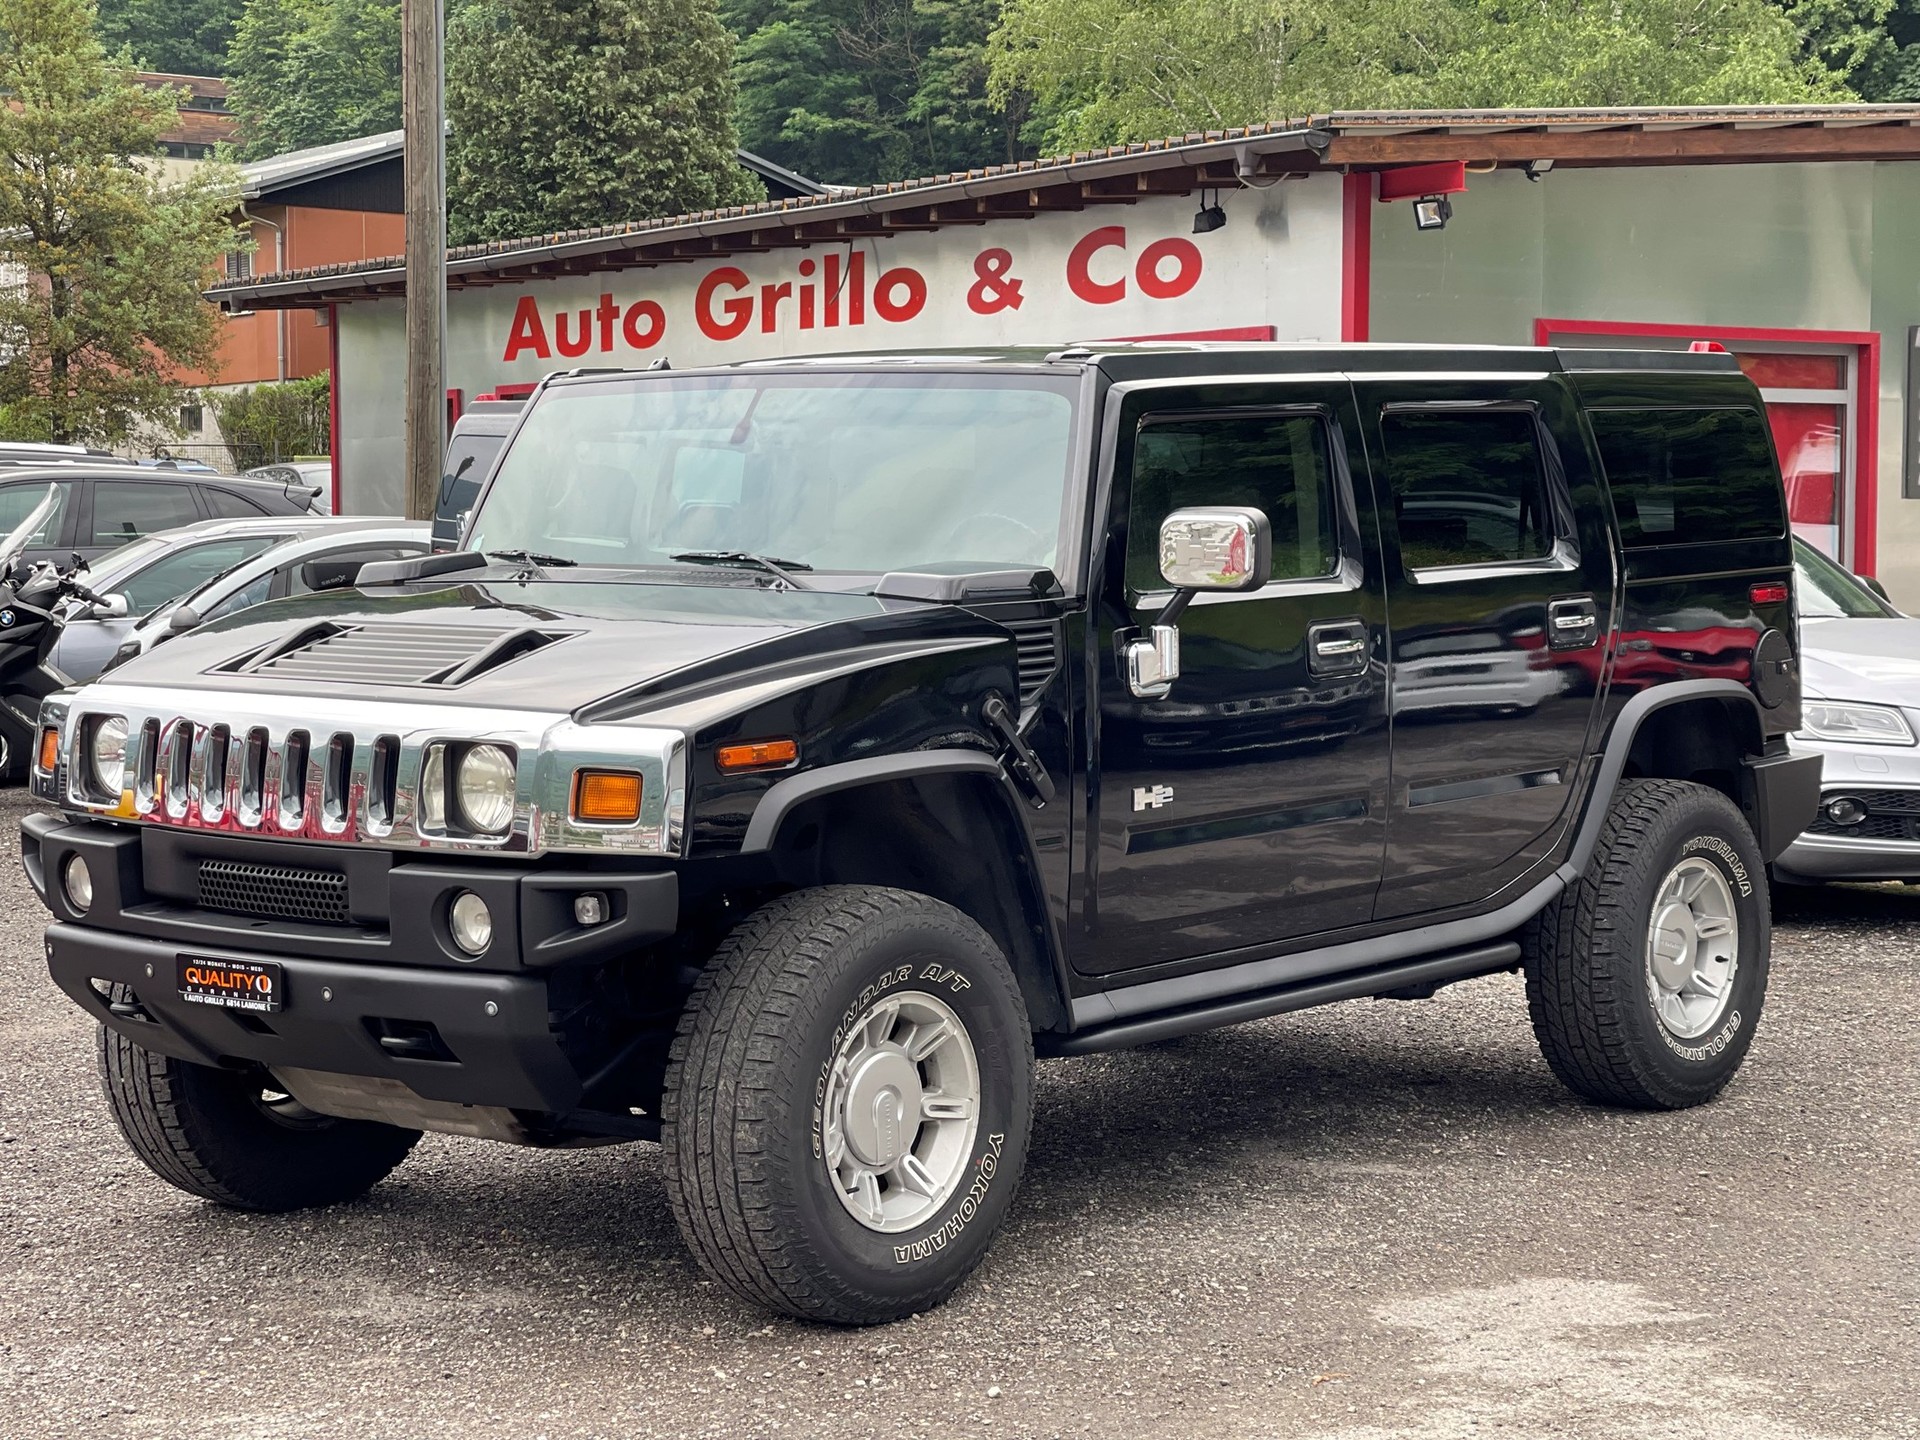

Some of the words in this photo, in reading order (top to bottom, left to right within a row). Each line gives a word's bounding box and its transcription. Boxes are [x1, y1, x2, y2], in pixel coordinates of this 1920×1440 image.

[504, 295, 665, 361] Auto
[696, 253, 926, 341] Grillo
[967, 248, 1024, 315] &
[1068, 227, 1202, 304] Co
[1131, 784, 1174, 812] H2
[1682, 835, 1753, 898] YOKOHAMA
[186, 967, 255, 990] QUALITY
[187, 985, 271, 1002] GARANTIE
[188, 994, 204, 1003] AUTO
[204, 997, 224, 1005] GRILLO
[226, 999, 241, 1008] 6814
[241, 1001, 266, 1010] LAMONE
[1656, 1010, 1742, 1061] GEOLANDAR
[812, 964, 913, 1160] GEOLANDAR
[919, 963, 972, 993] A/T
[893, 1133, 1005, 1264] YOKOHAMA
